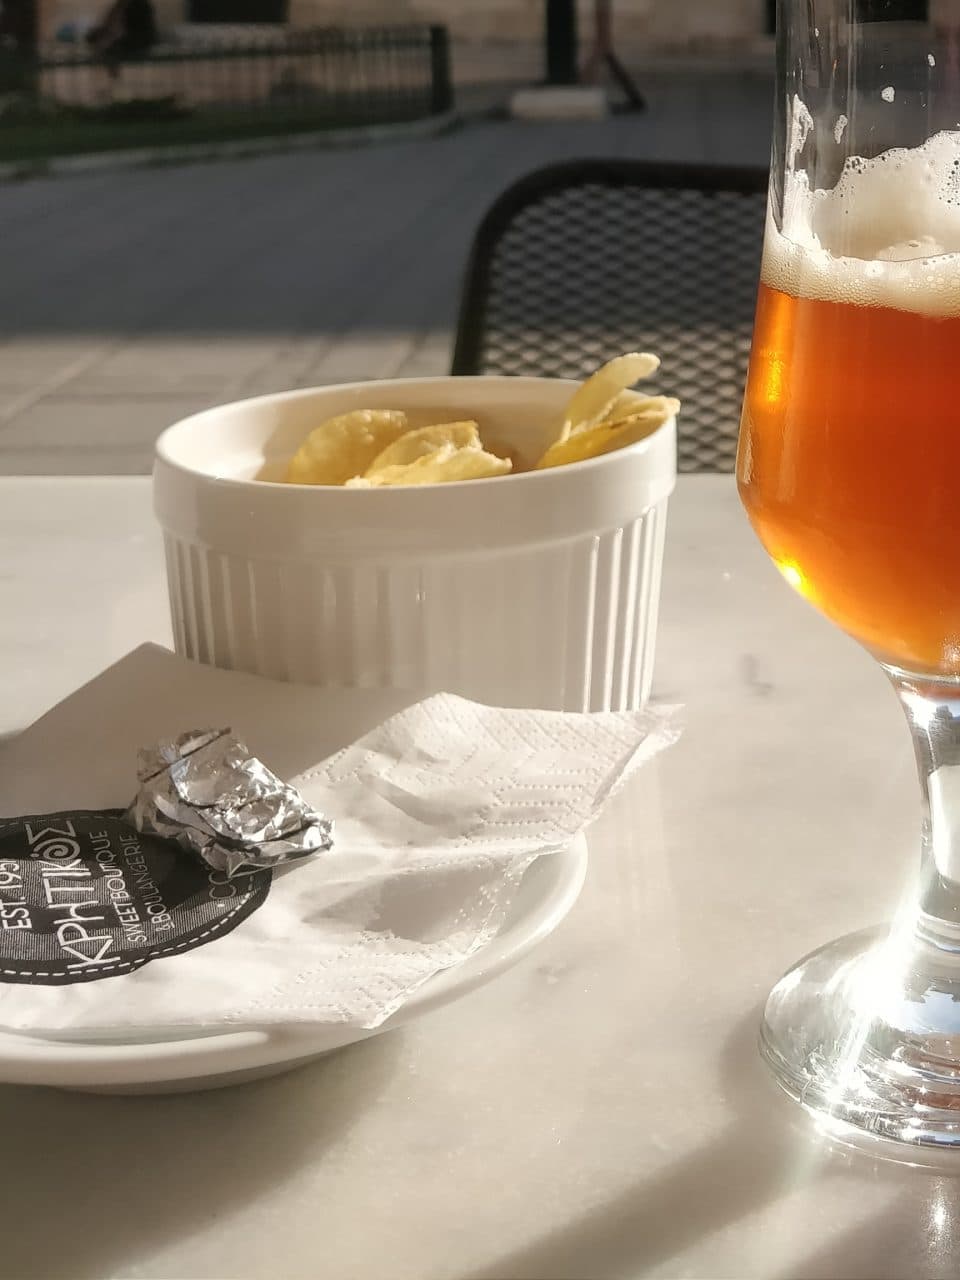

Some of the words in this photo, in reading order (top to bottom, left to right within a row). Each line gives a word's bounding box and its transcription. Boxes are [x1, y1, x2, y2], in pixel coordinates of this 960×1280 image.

[88, 829, 131, 900] BOUTIQUE
[0, 895, 33, 930] EST.
[112, 900, 148, 943] SWEET
